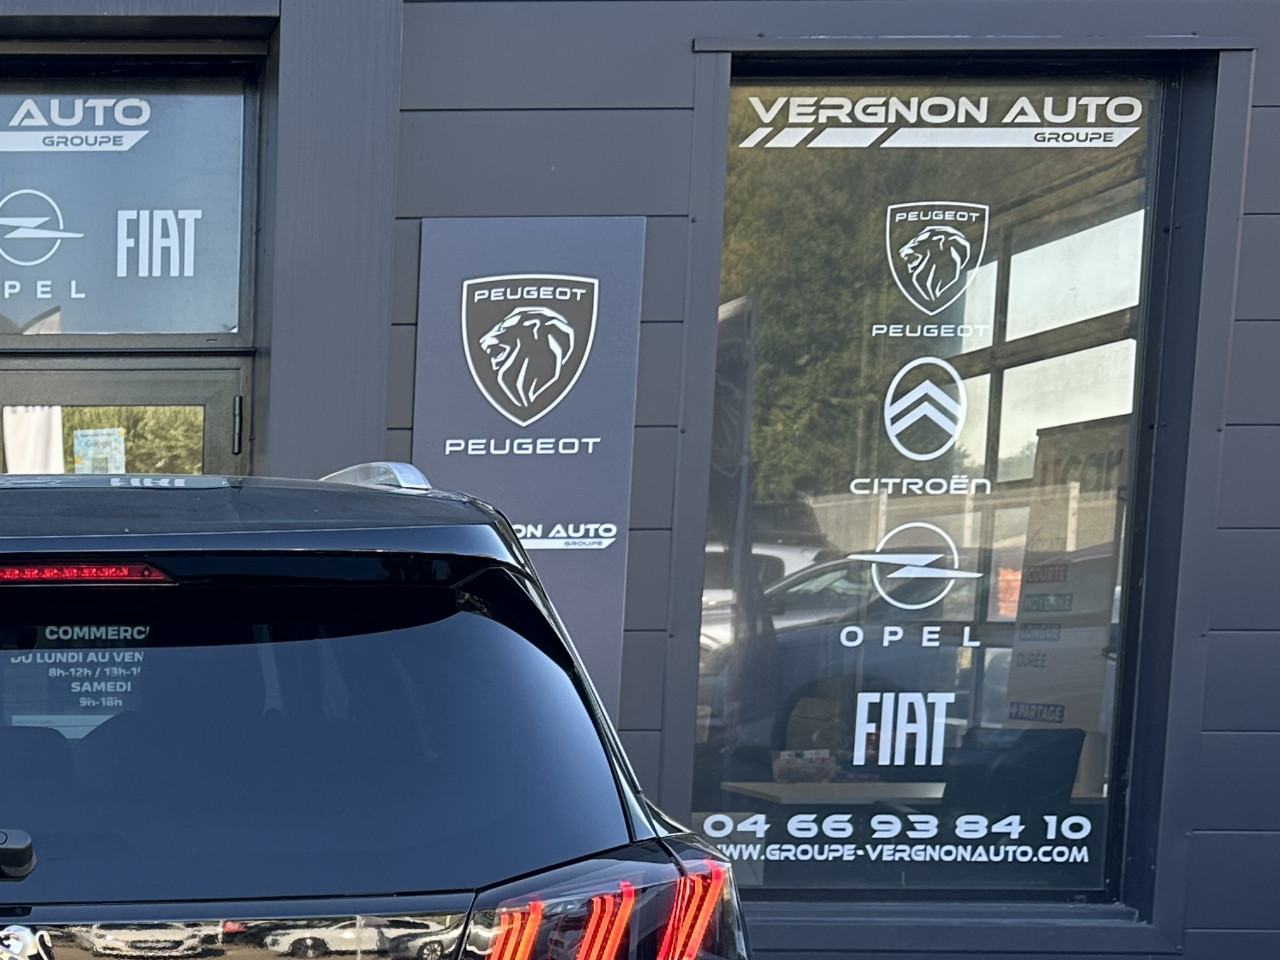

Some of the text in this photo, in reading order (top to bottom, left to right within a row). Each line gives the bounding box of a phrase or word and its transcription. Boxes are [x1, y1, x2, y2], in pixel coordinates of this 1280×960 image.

[8, 97, 151, 127] AUTO
[748, 96, 1143, 125] VERGNON AUTO
[41, 135, 124, 147] GROUPE
[1033, 131, 1115, 144] GROUPE
[895, 210, 980, 223] PEUGEOT
[116, 209, 202, 277] FIAT
[474, 286, 586, 302] PEUGEOT
[871, 324, 990, 338] PEUGEOT
[445, 437, 601, 455] PEUGEOT
[548, 523, 618, 538] AUTO
[840, 626, 981, 647] OPEL
[36, 652, 83, 663] LUNDI
[86, 652, 109, 662] AU
[48, 667, 92, 678] 8h-12h
[70, 682, 131, 692] SAMEDI
[79, 697, 123, 707] 9h-18h
[852, 692, 955, 766] FIAT
[703, 814, 1092, 840] 04 66 93 84 10
